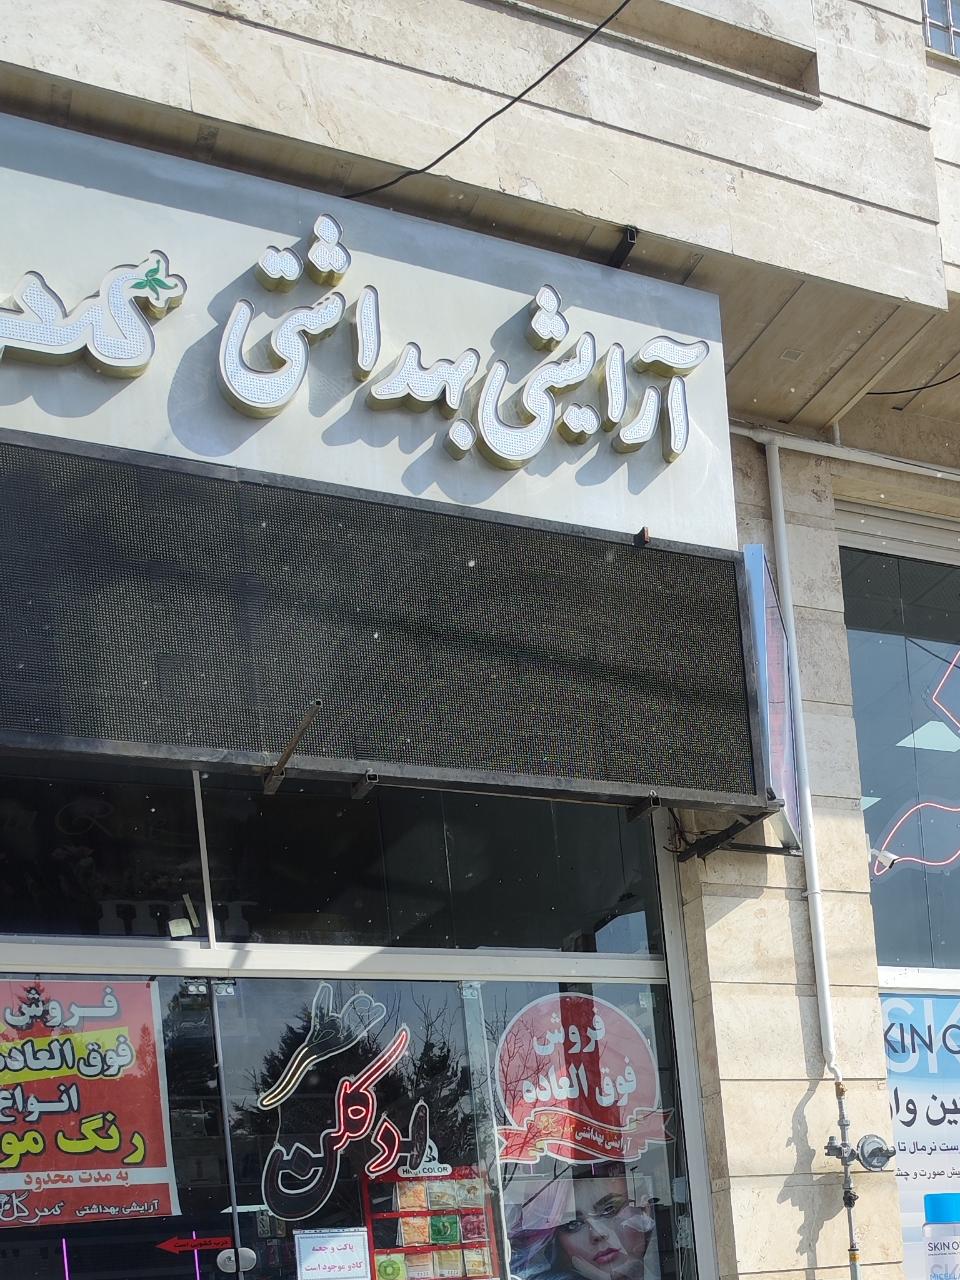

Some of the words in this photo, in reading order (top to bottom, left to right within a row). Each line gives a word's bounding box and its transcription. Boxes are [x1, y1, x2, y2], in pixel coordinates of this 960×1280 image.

[219, 213, 480, 460] بهداشتی
[477, 285, 709, 469] آرایشی
[4, 985, 119, 1029] فروش
[532, 1006, 606, 1056] فروش
[77, 1035, 133, 1077] فوق
[522, 1062, 589, 1104] العاده
[595, 1055, 637, 1107] فوق
[56, 1111, 146, 1164] رنگ
[897, 1141, 907, 1152] تا
[908, 1141, 937, 1155] نرمال
[79, 1170, 112, 1183] مدت
[116, 1170, 129, 1187] به
[422, 1166, 449, 1175] COLOR
[912, 1172, 918, 1180] و
[919, 1169, 945, 1180] صورت
[24, 1172, 74, 1190] محدود
[75, 1200, 119, 1216] بهداشتی
[122, 1199, 160, 1214] آرایشی
[928, 1241, 950, 1252] SKIN
[304, 1263, 321, 1272] است
